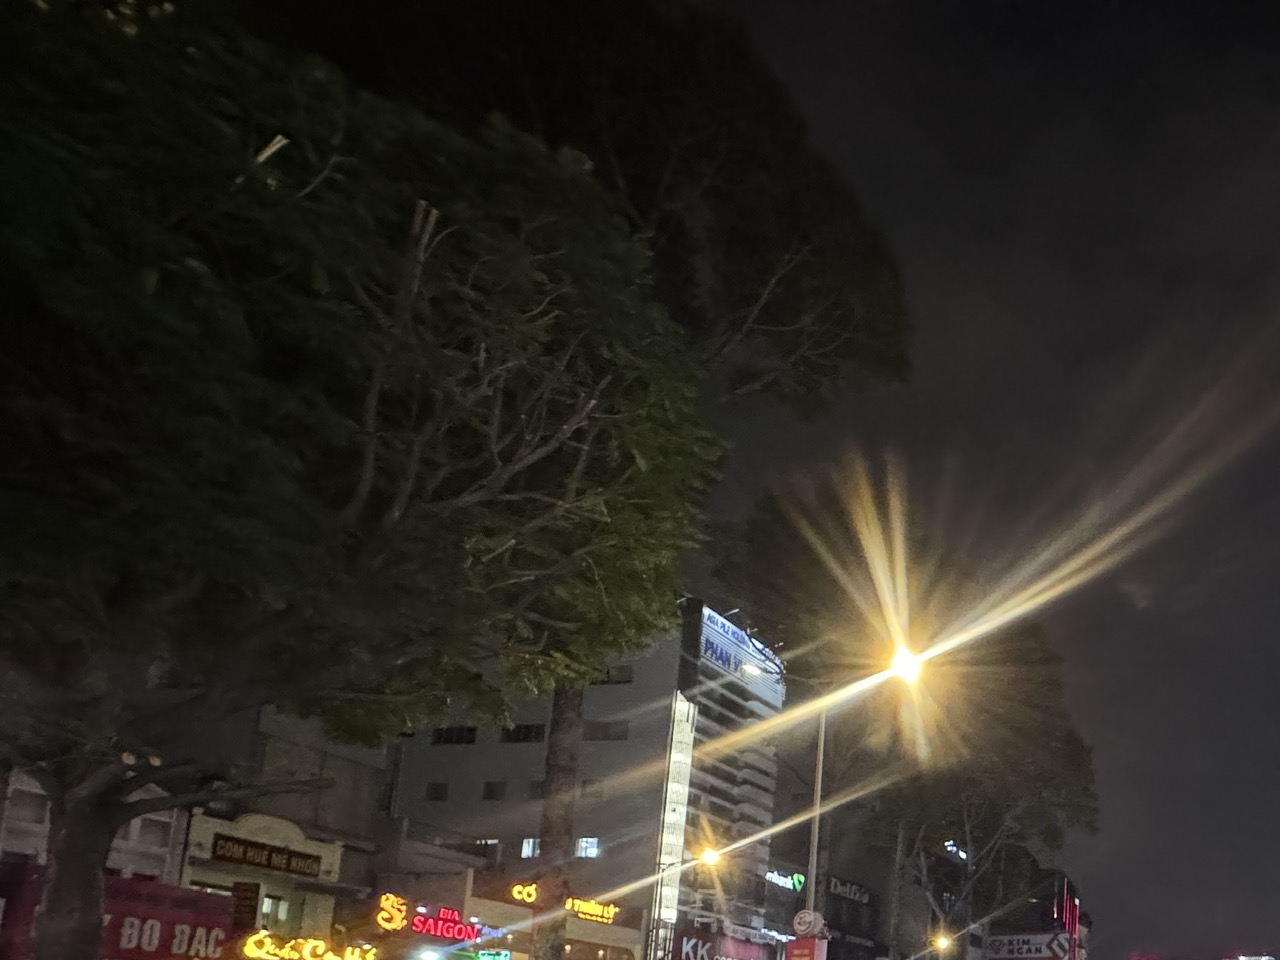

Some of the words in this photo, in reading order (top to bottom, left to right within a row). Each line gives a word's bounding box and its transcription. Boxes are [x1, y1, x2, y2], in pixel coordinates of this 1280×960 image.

[439, 907, 460, 921] BIA
[412, 915, 479, 942] SAIGON
[1007, 938, 1031, 947] KIM
